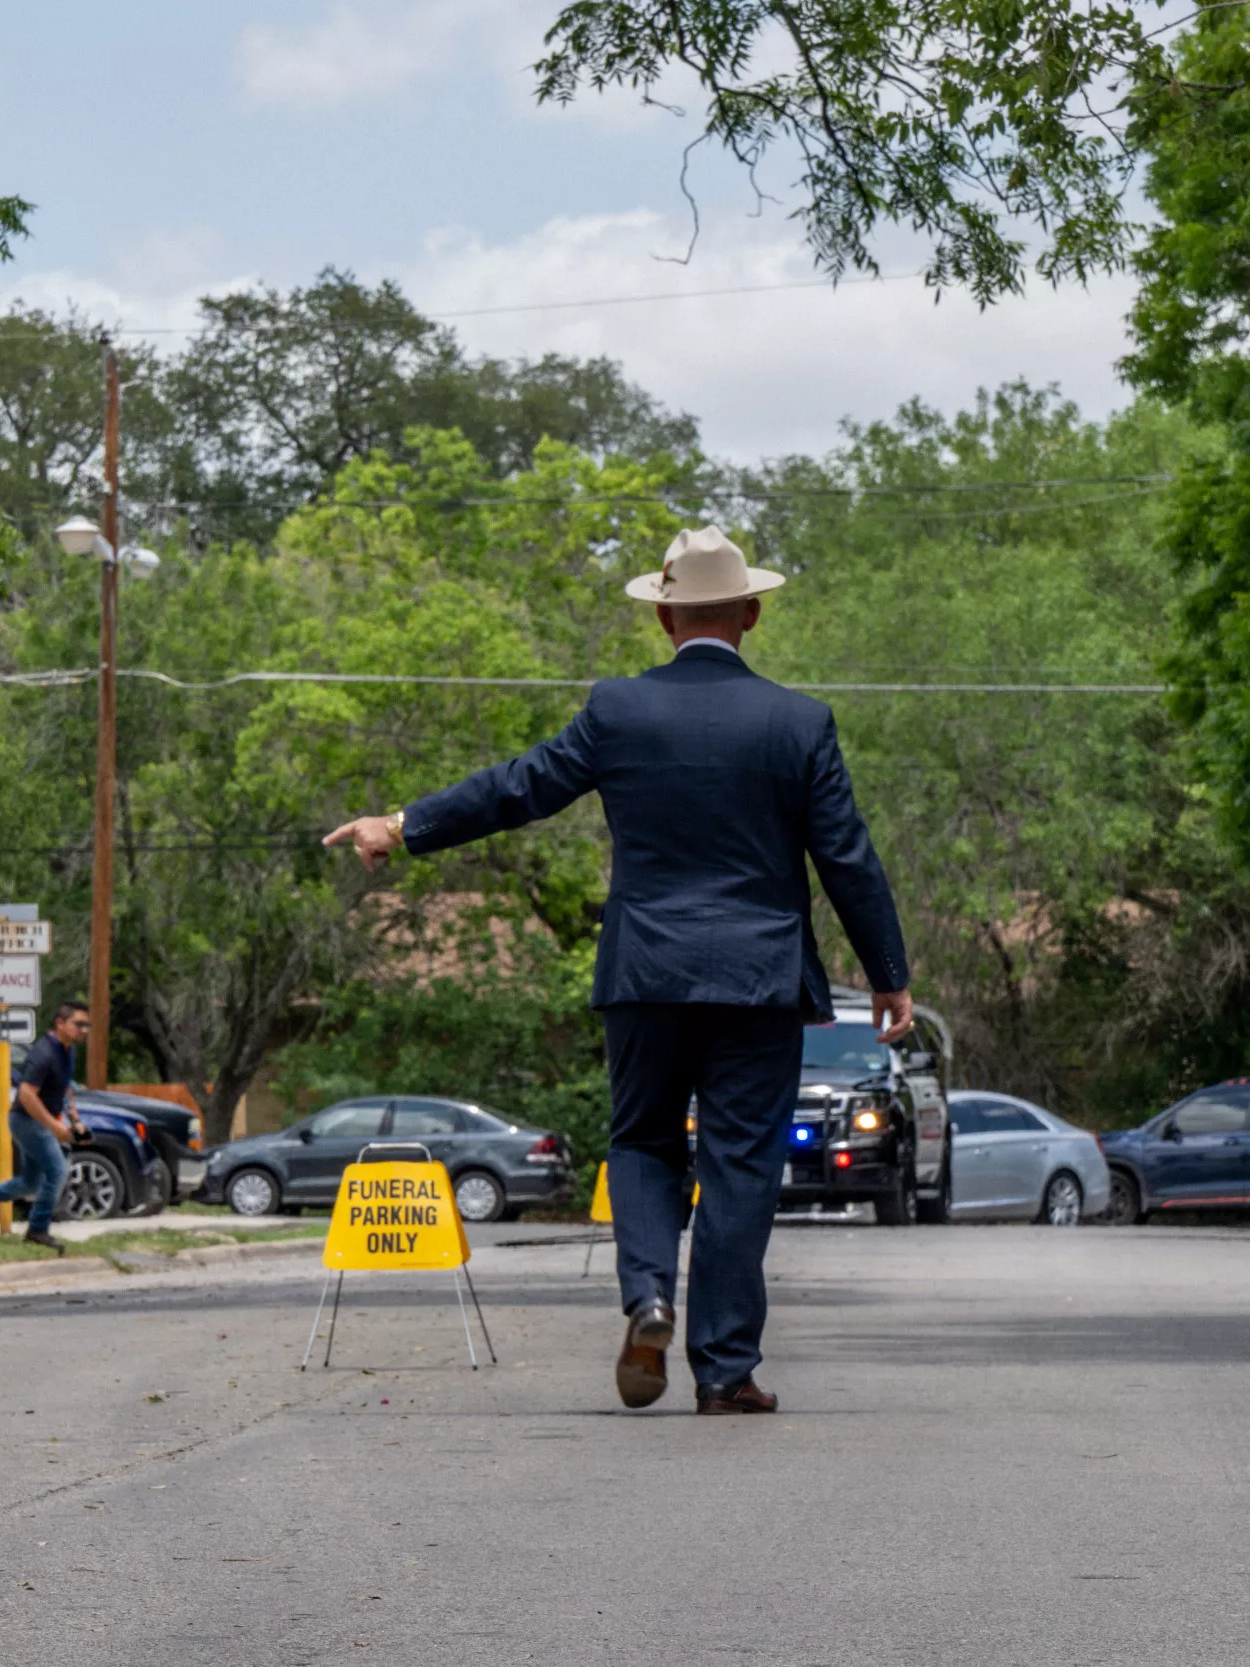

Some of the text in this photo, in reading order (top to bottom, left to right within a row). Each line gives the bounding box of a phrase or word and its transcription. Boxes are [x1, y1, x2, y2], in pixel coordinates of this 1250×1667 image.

[348, 1179, 441, 1200] FUNERAL
[350, 1206, 438, 1226] PARKING
[367, 1232, 418, 1253] ONLY
